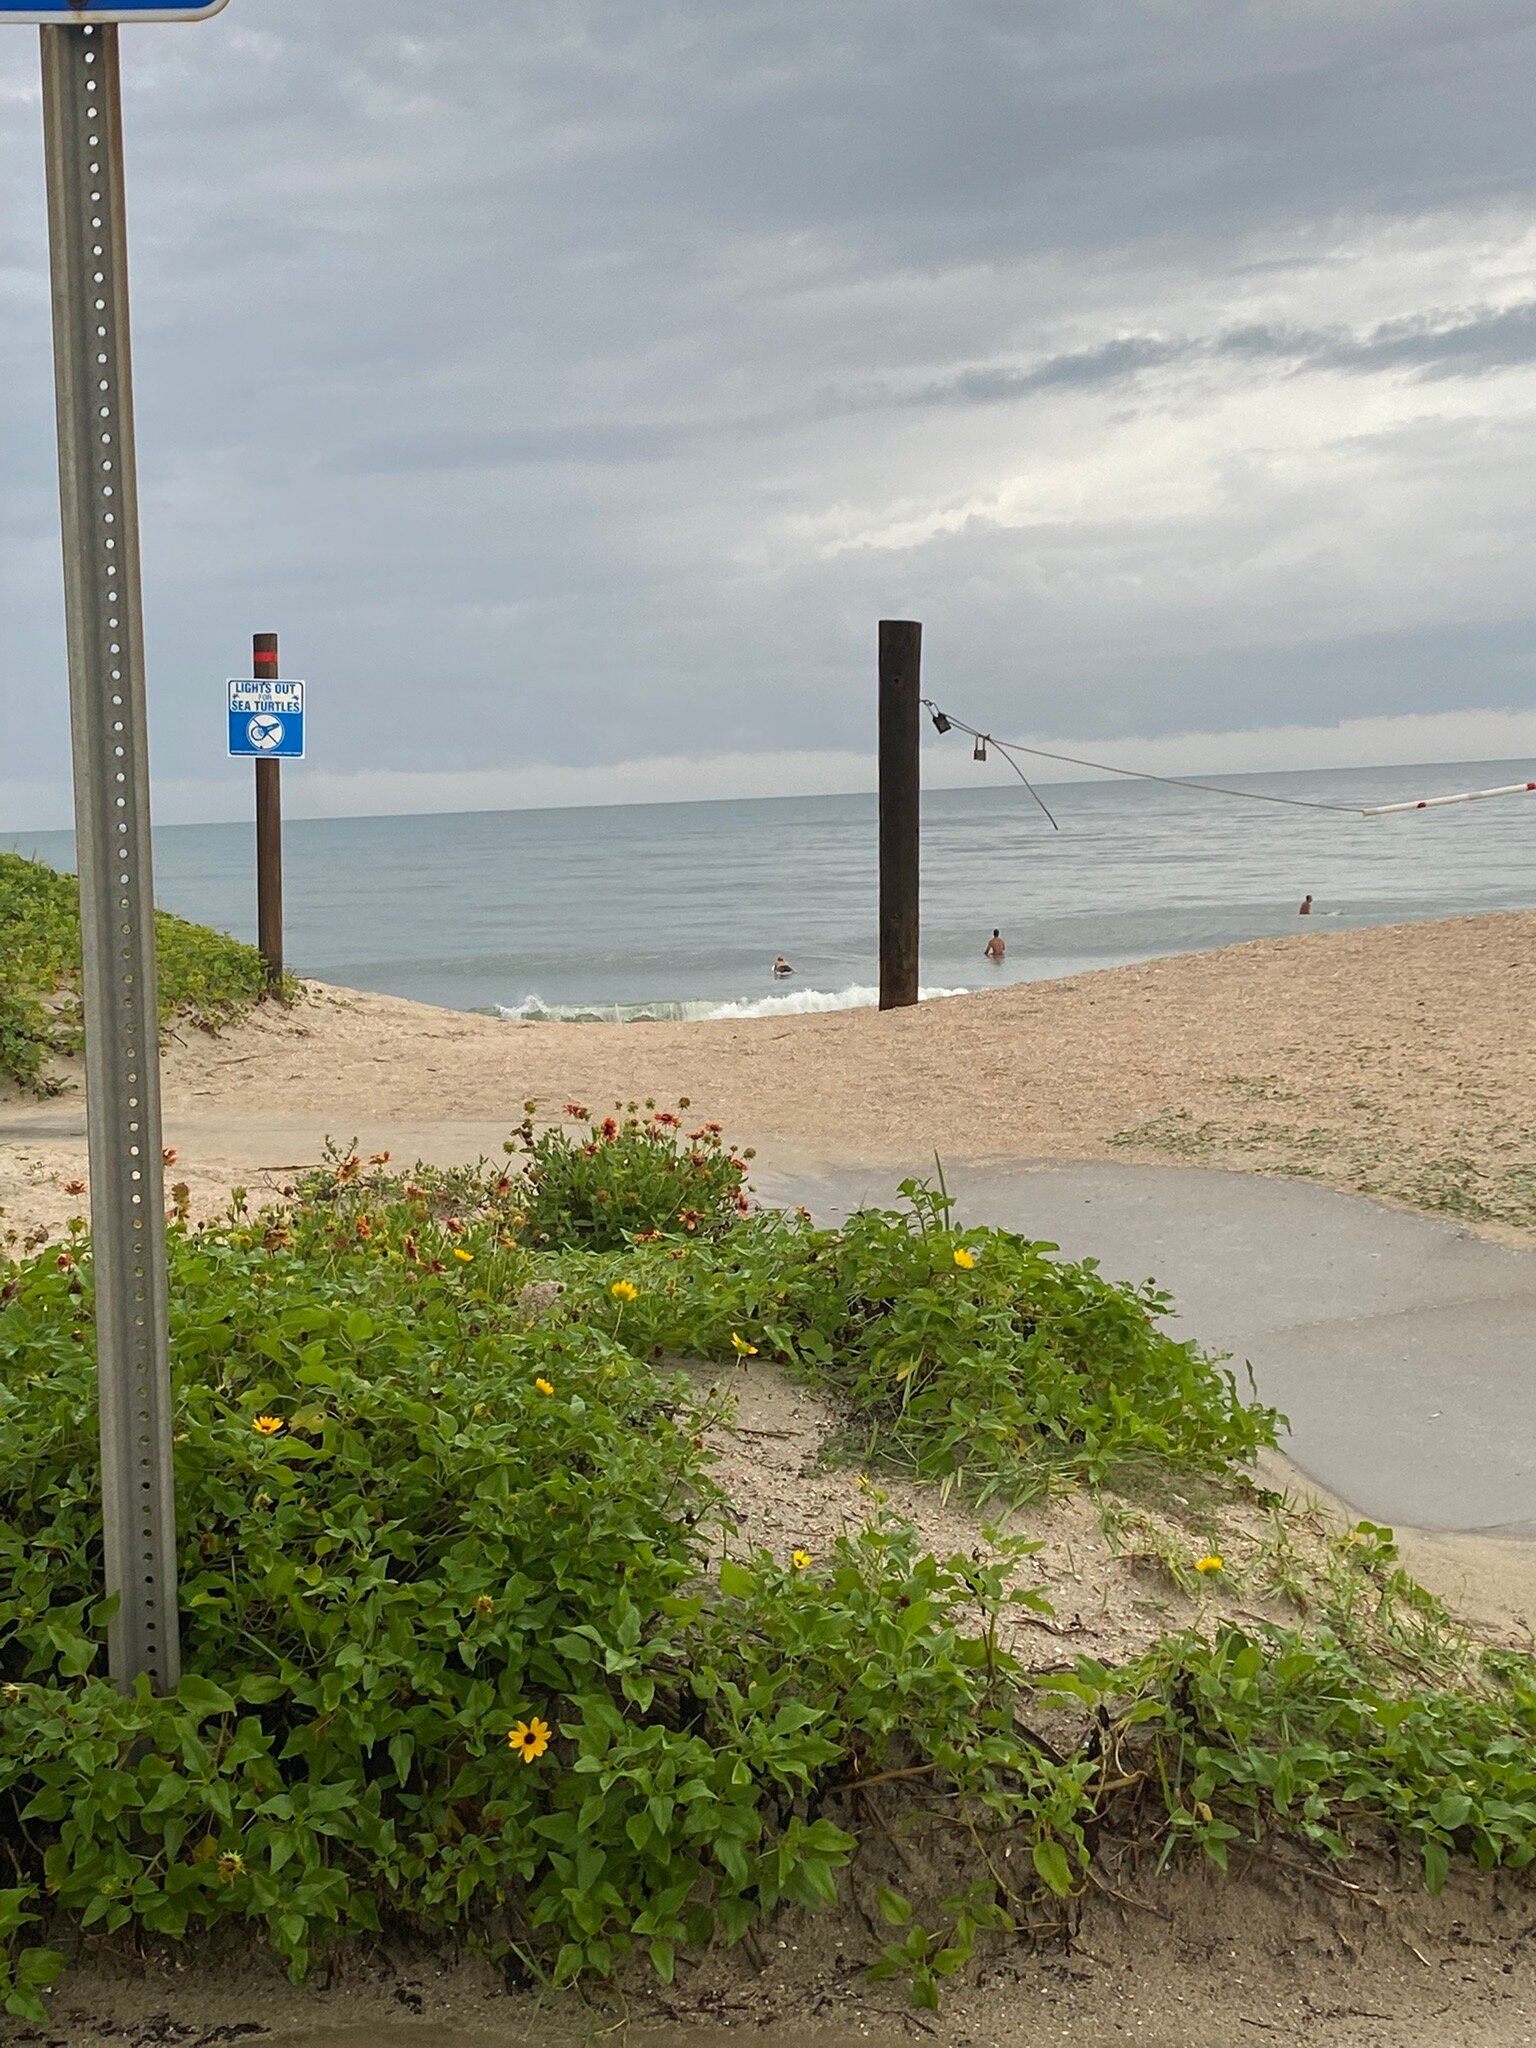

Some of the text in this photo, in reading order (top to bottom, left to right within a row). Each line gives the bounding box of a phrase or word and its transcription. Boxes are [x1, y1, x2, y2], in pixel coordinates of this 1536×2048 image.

[236, 682, 295, 694] LIGHTS OUT
[232, 700, 300, 712] SEA TURTLES
